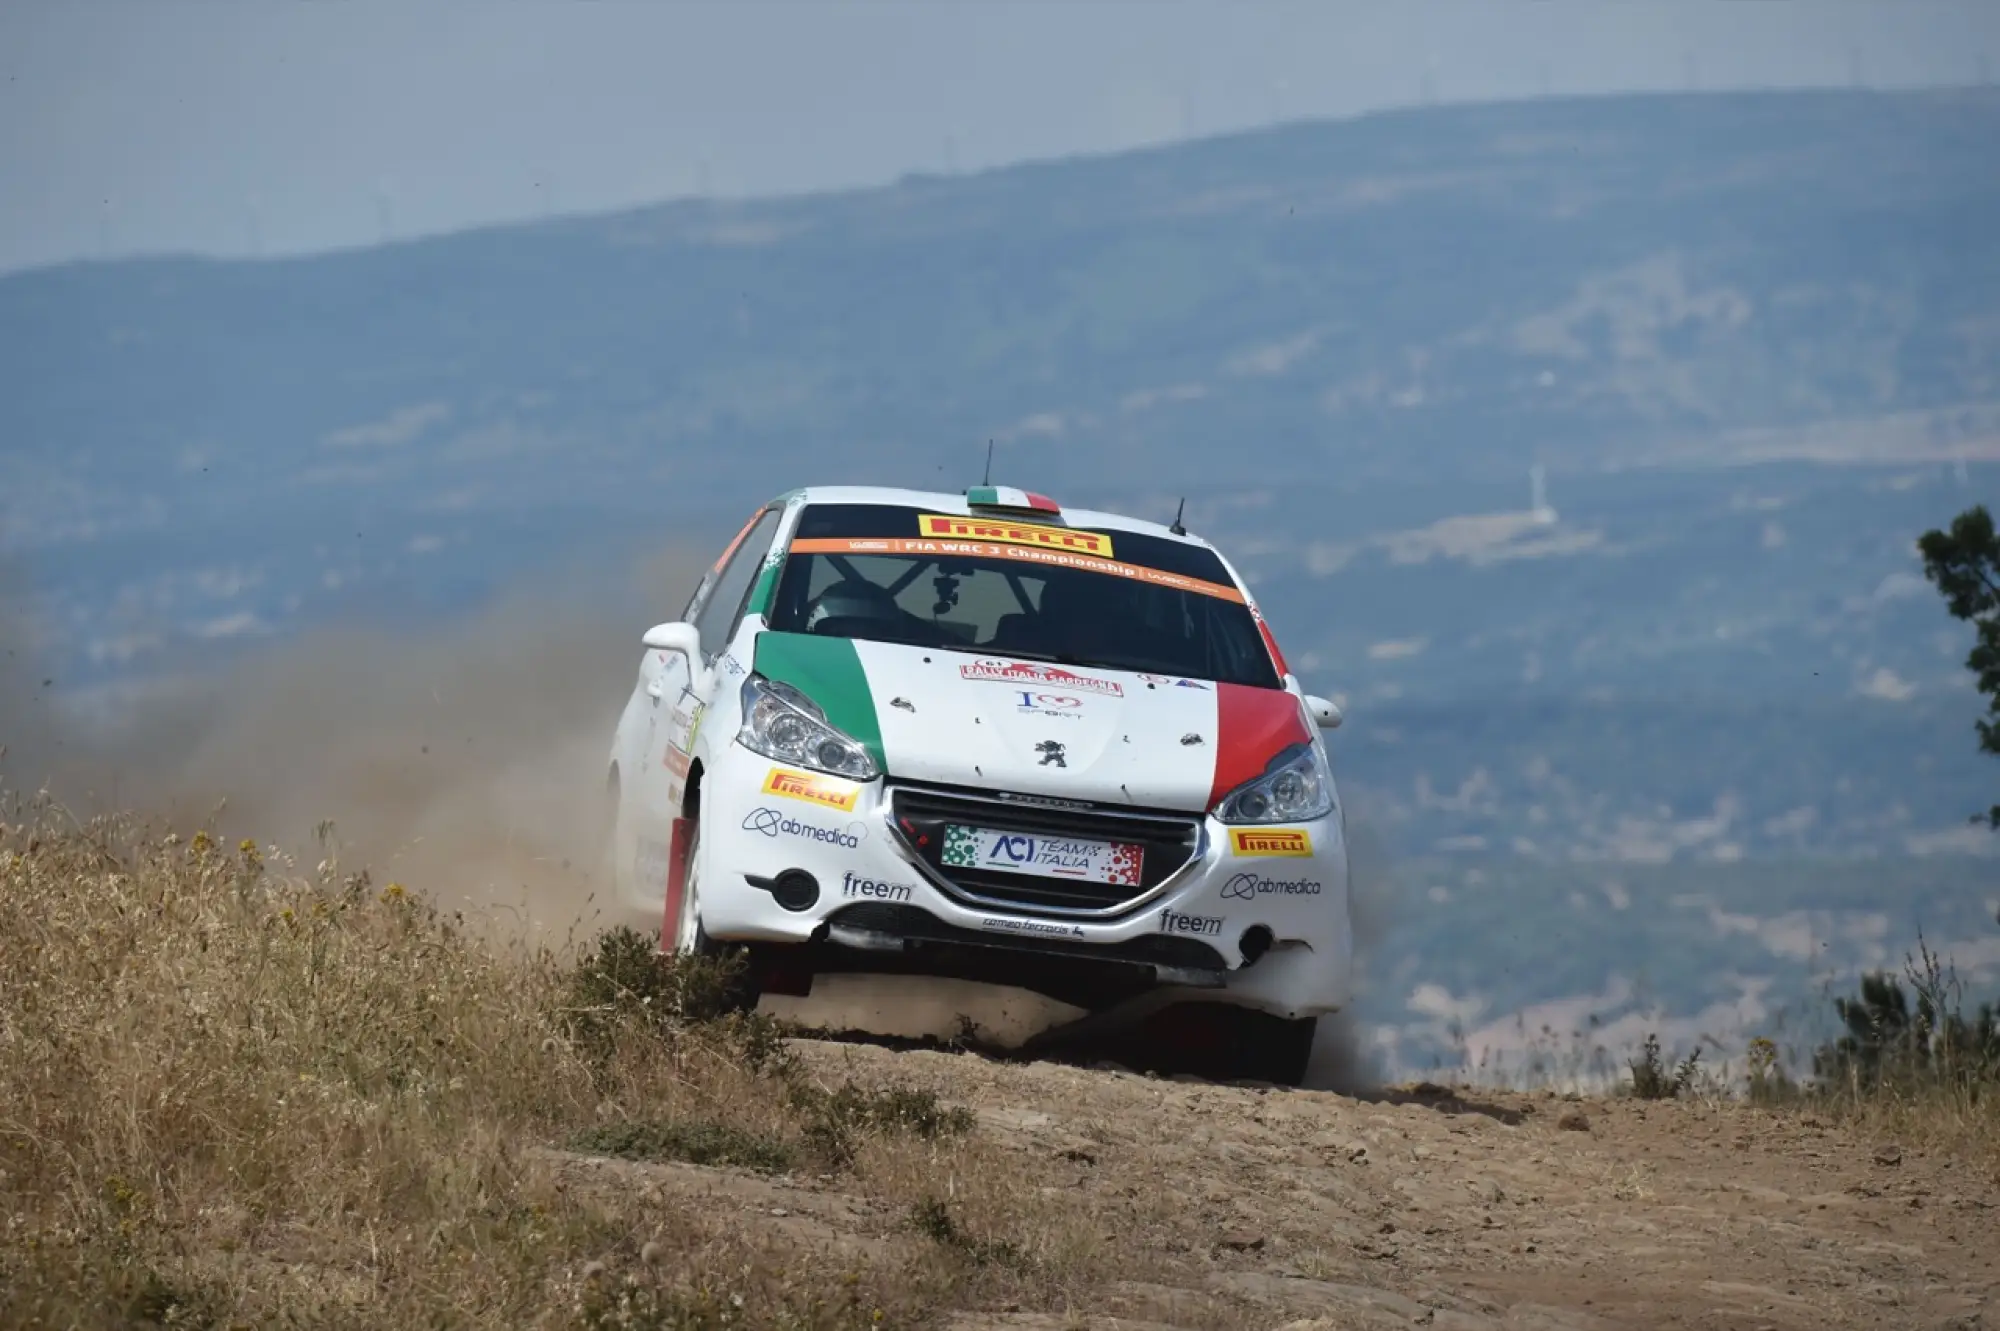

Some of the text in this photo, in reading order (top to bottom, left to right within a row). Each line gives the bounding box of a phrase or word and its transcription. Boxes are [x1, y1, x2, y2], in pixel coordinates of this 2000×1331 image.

[930, 518, 1100, 551] PIRELLI
[905, 541, 1136, 577] FIA WRC 3 Championship
[965, 664, 1120, 693] RALLY ITALIA SARDEGNA
[771, 774, 847, 805] PIRELLI
[989, 835, 1035, 863] ACI
[1040, 840, 1087, 855] TEAM
[1237, 832, 1306, 851] PIRELLI
[1034, 853, 1090, 868] ITALIA
[843, 872, 912, 901] freem
[1160, 909, 1223, 935] freem
